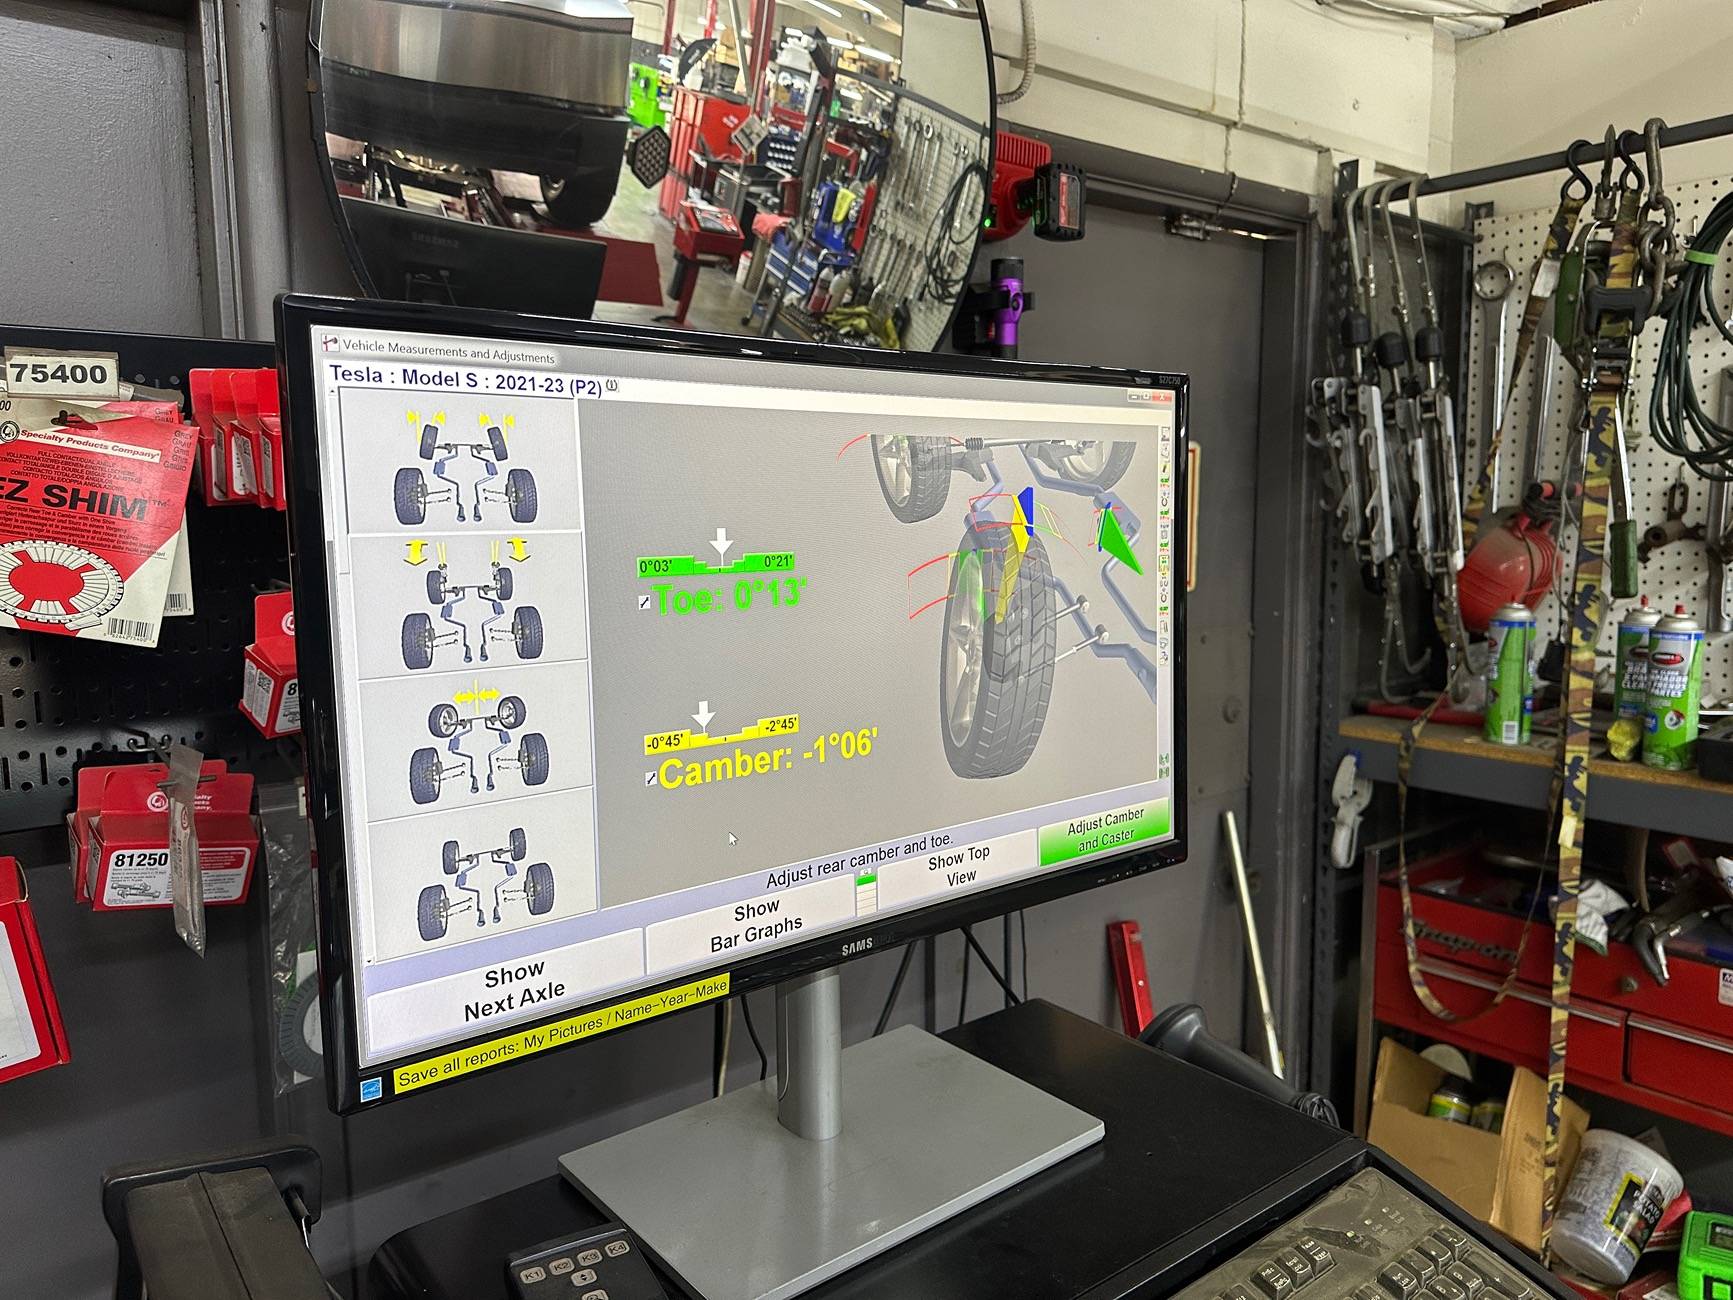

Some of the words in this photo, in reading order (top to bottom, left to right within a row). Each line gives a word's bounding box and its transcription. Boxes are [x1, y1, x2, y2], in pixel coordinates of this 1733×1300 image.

[343, 339, 385, 352] Vehicle
[388, 342, 467, 358] Measurements
[471, 349, 490, 359] and
[493, 350, 555, 364] Adjustments
[10, 364, 108, 383] 75400
[329, 365, 383, 383] Tesla
[402, 368, 460, 388] Model
[466, 373, 478, 388] S
[495, 374, 564, 393] 2021-23
[570, 379, 602, 399] (P2)
[20, 429, 64, 444] Specialty
[66, 436, 109, 451] Products
[42, 484, 148, 521] SHIM
[639, 559, 672, 573] 0°03'
[764, 555, 793, 567] 0°21'
[651, 583, 722, 616] Toe:
[734, 576, 807, 610] 0°13'
[765, 717, 797, 732] -2°45'
[647, 734, 684, 750] -0°45'
[658, 747, 792, 789] Camber:
[803, 727, 879, 763] -1°06'
[1068, 818, 1102, 836] Adjust
[1105, 808, 1144, 826] Camber
[1079, 836, 1098, 852] and
[1101, 829, 1135, 846] Caster
[114, 853, 169, 867] 81250
[766, 865, 812, 889] Adjust
[817, 859, 846, 876] rear
[850, 846, 900, 868] camber
[904, 837, 927, 854] and
[931, 834, 954, 848] toe.
[928, 852, 964, 871] Show
[968, 846, 990, 861] Top
[947, 870, 977, 887] View
[734, 899, 780, 922] Show
[711, 934, 740, 953] Bar
[744, 916, 803, 943] Graphs
[484, 962, 545, 988] Show
[464, 992, 514, 1022] Next
[519, 982, 565, 1007] Axle
[399, 1067, 438, 1087] Save
[443, 1057, 460, 1074] all
[465, 1042, 519, 1068] reports:
[524, 1034, 544, 1049] My
[549, 1018, 603, 1042] Pictures
[606, 1012, 611, 1025] /
[582, 1253, 599, 1262] K3
[609, 1244, 625, 1254] K4
[525, 1270, 541, 1281] K1
[554, 1262, 570, 1272] K2
